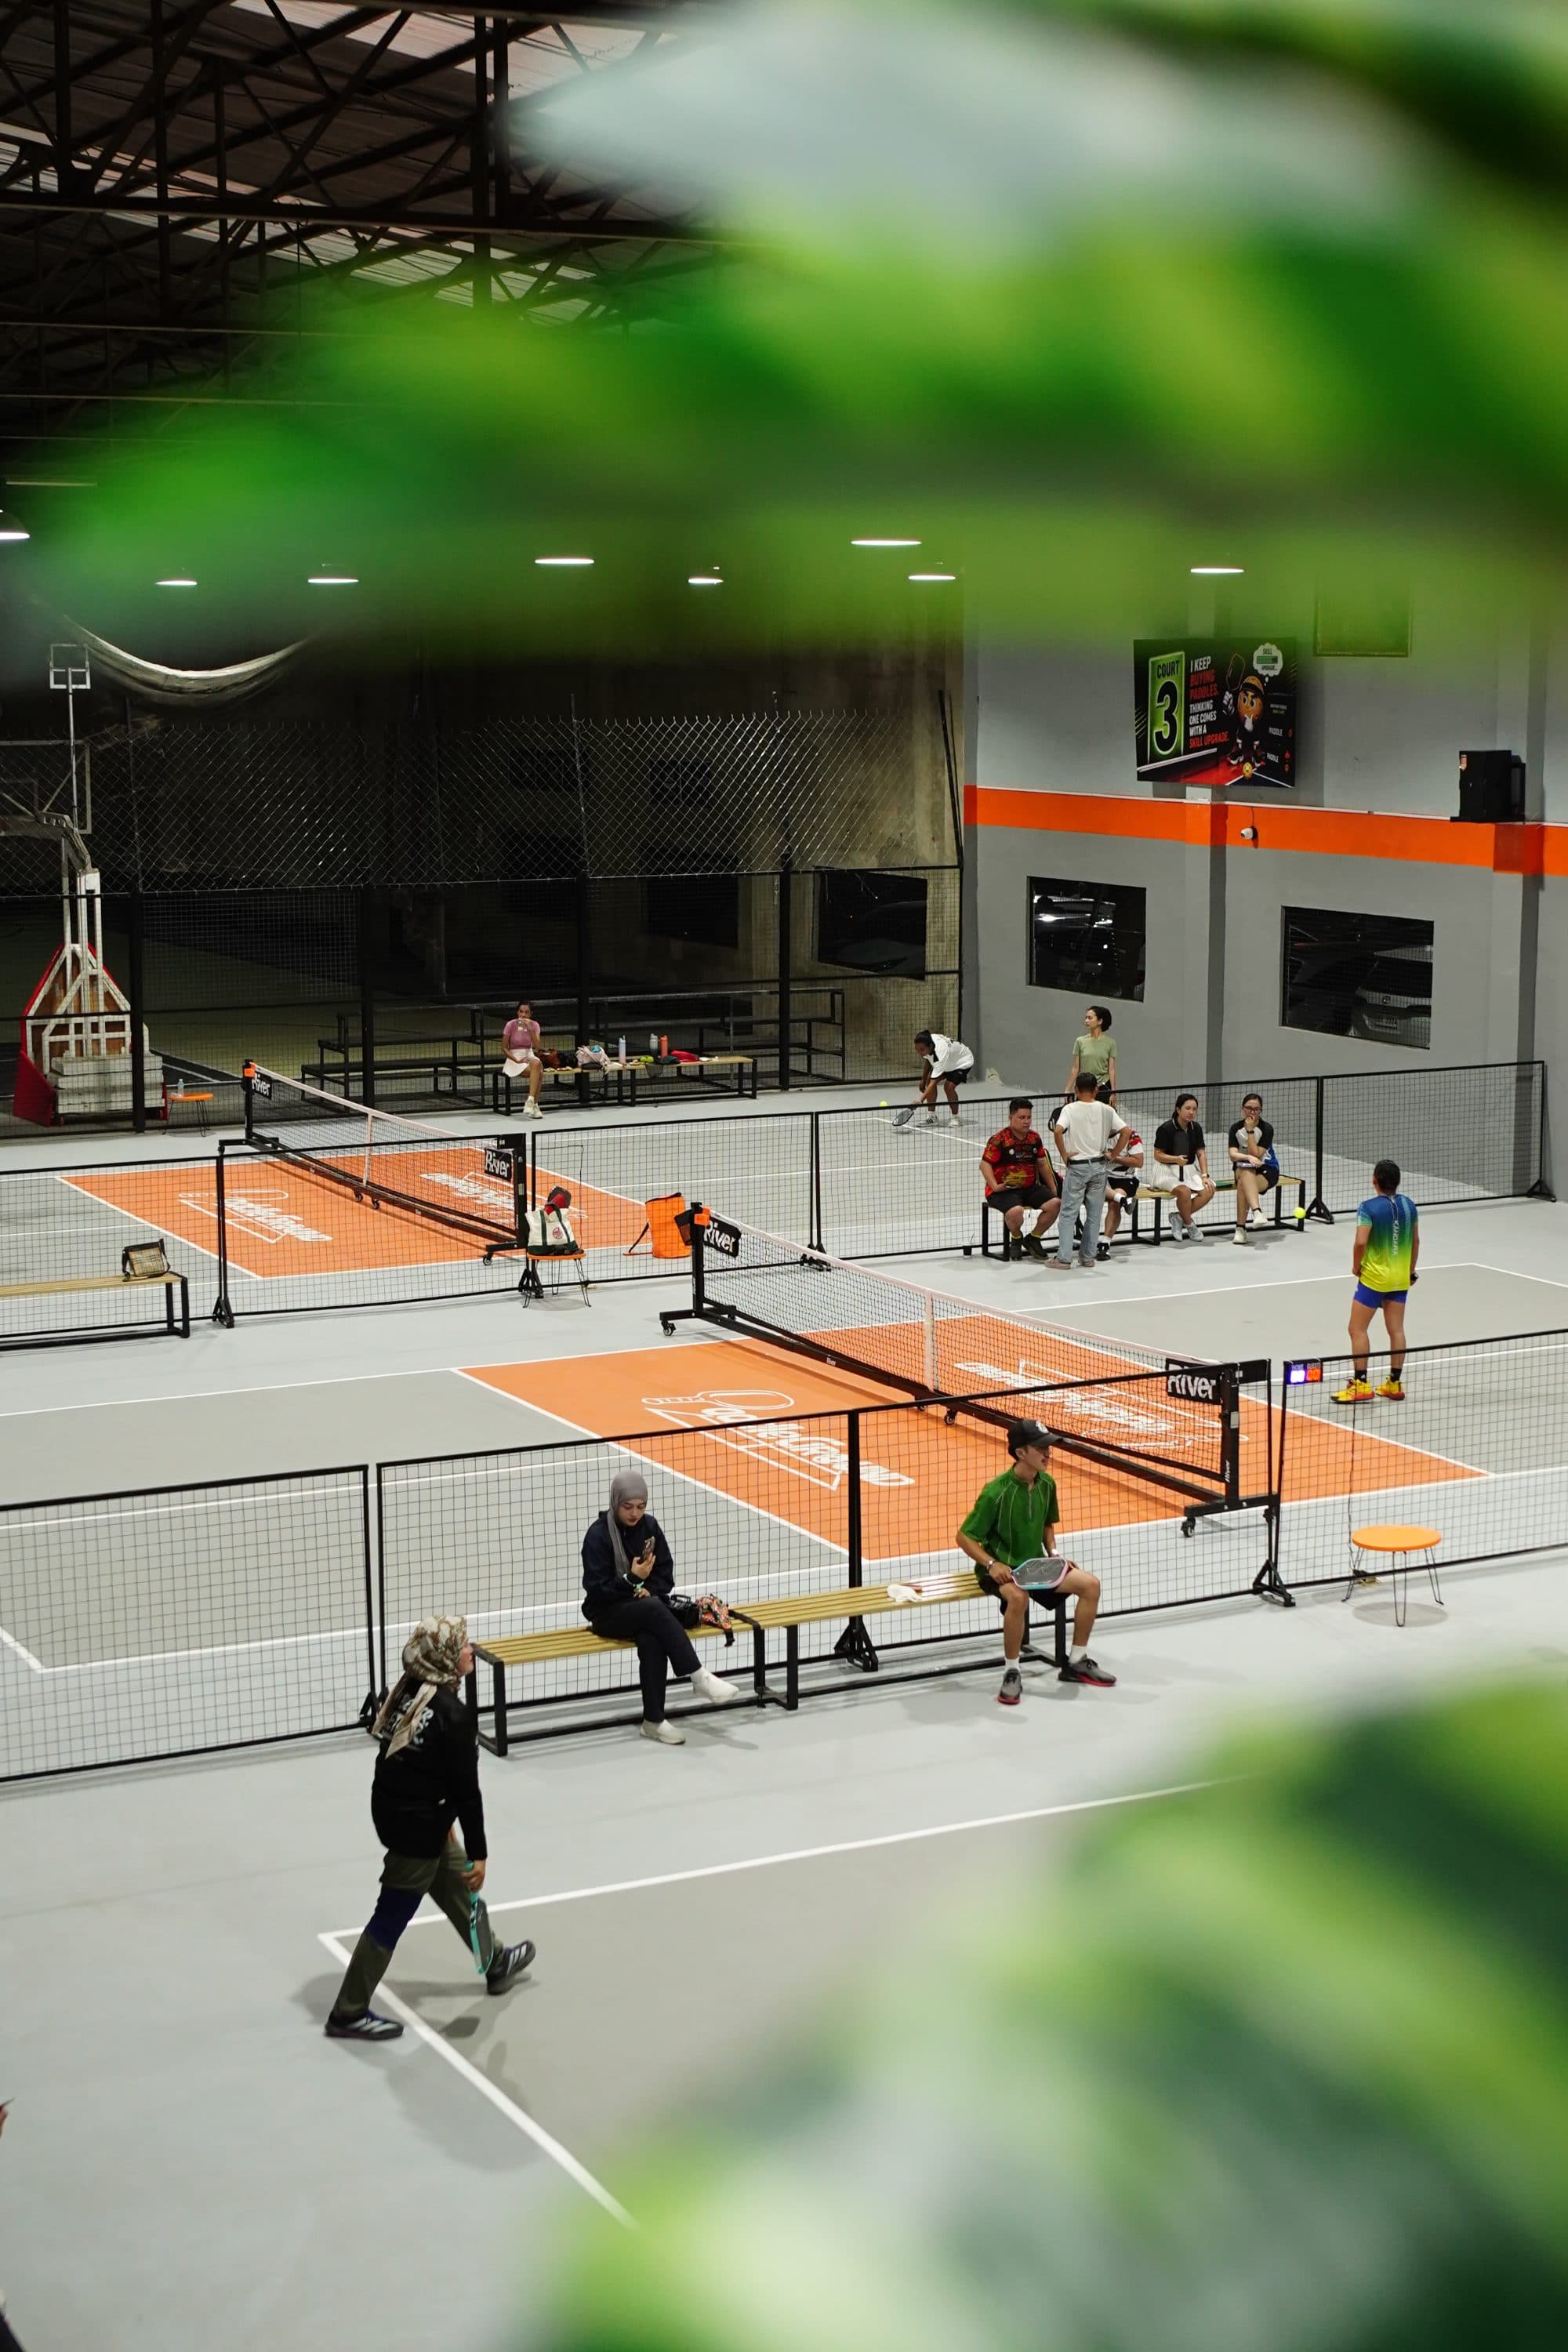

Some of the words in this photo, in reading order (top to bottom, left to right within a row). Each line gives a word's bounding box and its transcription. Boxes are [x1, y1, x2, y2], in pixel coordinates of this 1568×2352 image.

[1156, 660, 1180, 678] COURT
[1194, 656, 1211, 672] KEEP
[1189, 699, 1213, 714] THINKING
[1154, 680, 1178, 755] 3
[1189, 713, 1200, 726] ONE
[1200, 710, 1217, 724] COMES
[1189, 724, 1203, 737] WITH
[1203, 724, 1207, 735] A
[1189, 738, 1203, 749] SKILL
[485, 1149, 510, 1178] River
[703, 1220, 736, 1253] River
